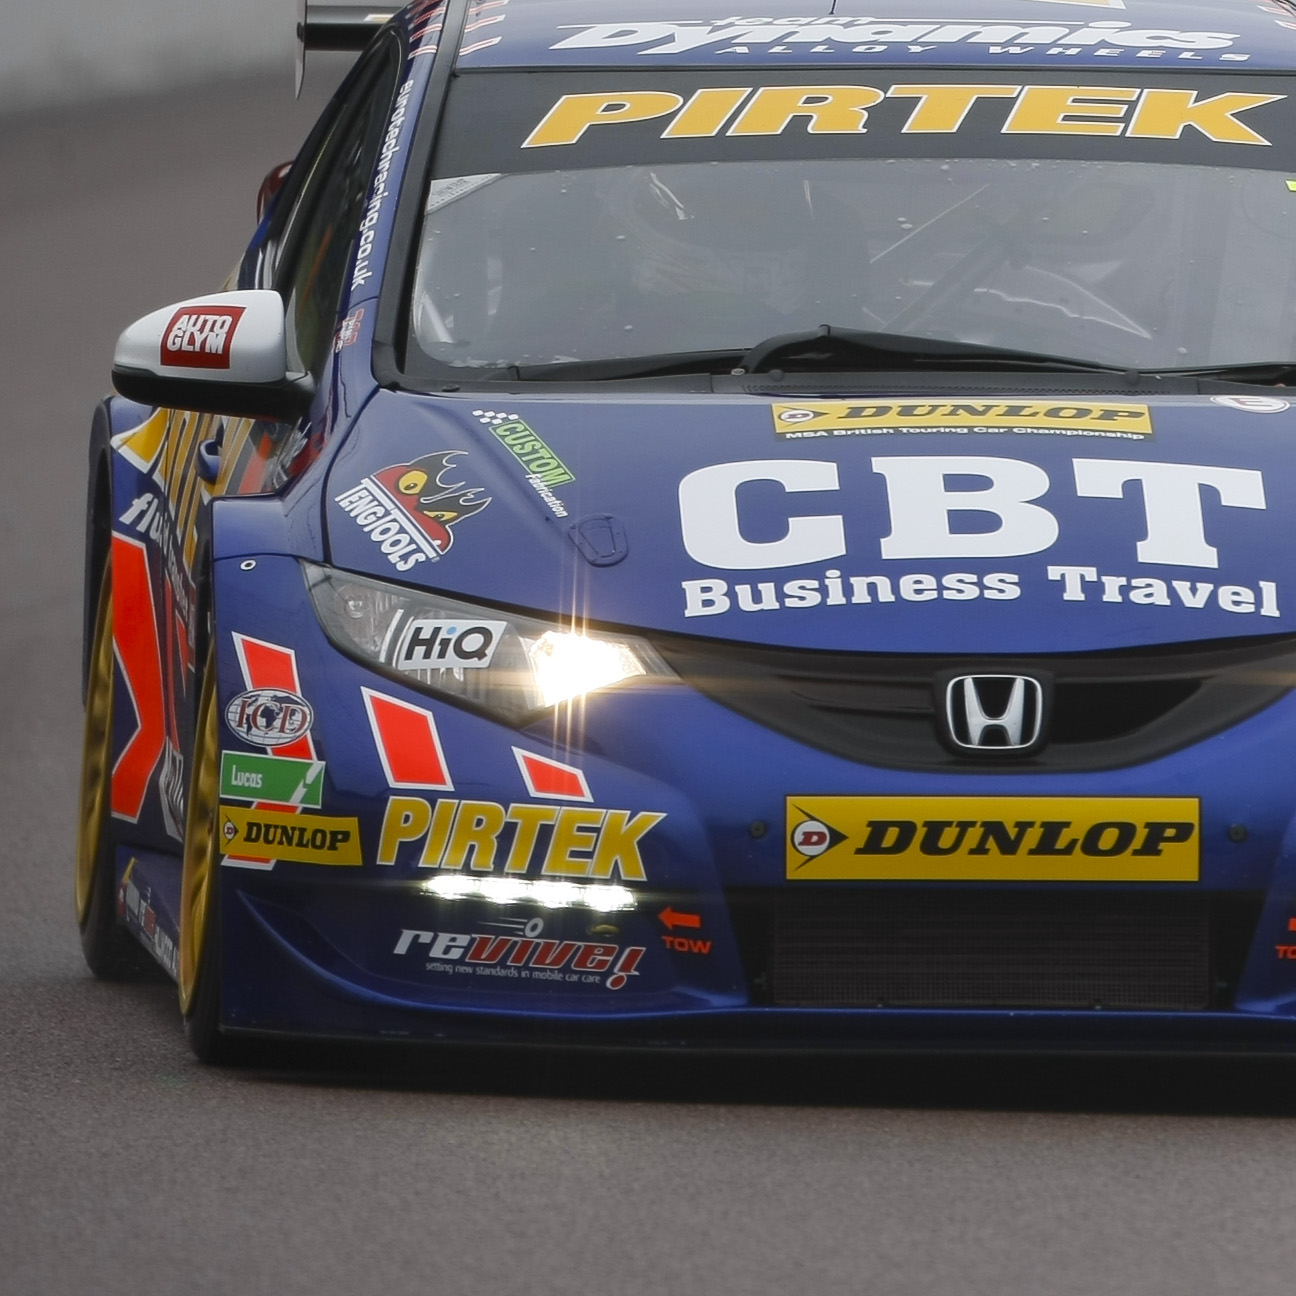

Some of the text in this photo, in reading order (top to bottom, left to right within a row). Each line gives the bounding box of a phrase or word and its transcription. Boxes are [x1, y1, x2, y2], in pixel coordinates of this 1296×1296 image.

[549, 21, 1240, 54] Dynamics
[715, 45, 1250, 62] ALLOY WHEELS
[521, 84, 1288, 148] PIRTEK
[171, 314, 233, 335] AUTO
[166, 330, 227, 355] GLYM
[837, 404, 1146, 421] DUNLOP
[786, 431, 829, 439] MSA
[833, 428, 894, 436] British
[1012, 427, 1145, 440] Championship
[495, 421, 571, 488] CUSTOM
[525, 472, 568, 518] Fabrication
[678, 455, 1266, 569] CBT
[681, 566, 1281, 617] Business Travel
[404, 625, 493, 661] HiQ
[236, 698, 308, 735] ICD
[243, 821, 351, 851] DUNLOP
[376, 796, 667, 882] PIRTEK
[853, 820, 1195, 857] DUNLOP
[662, 936, 712, 954] TOW
[426, 961, 600, 984] setting new standards in mobile car care
